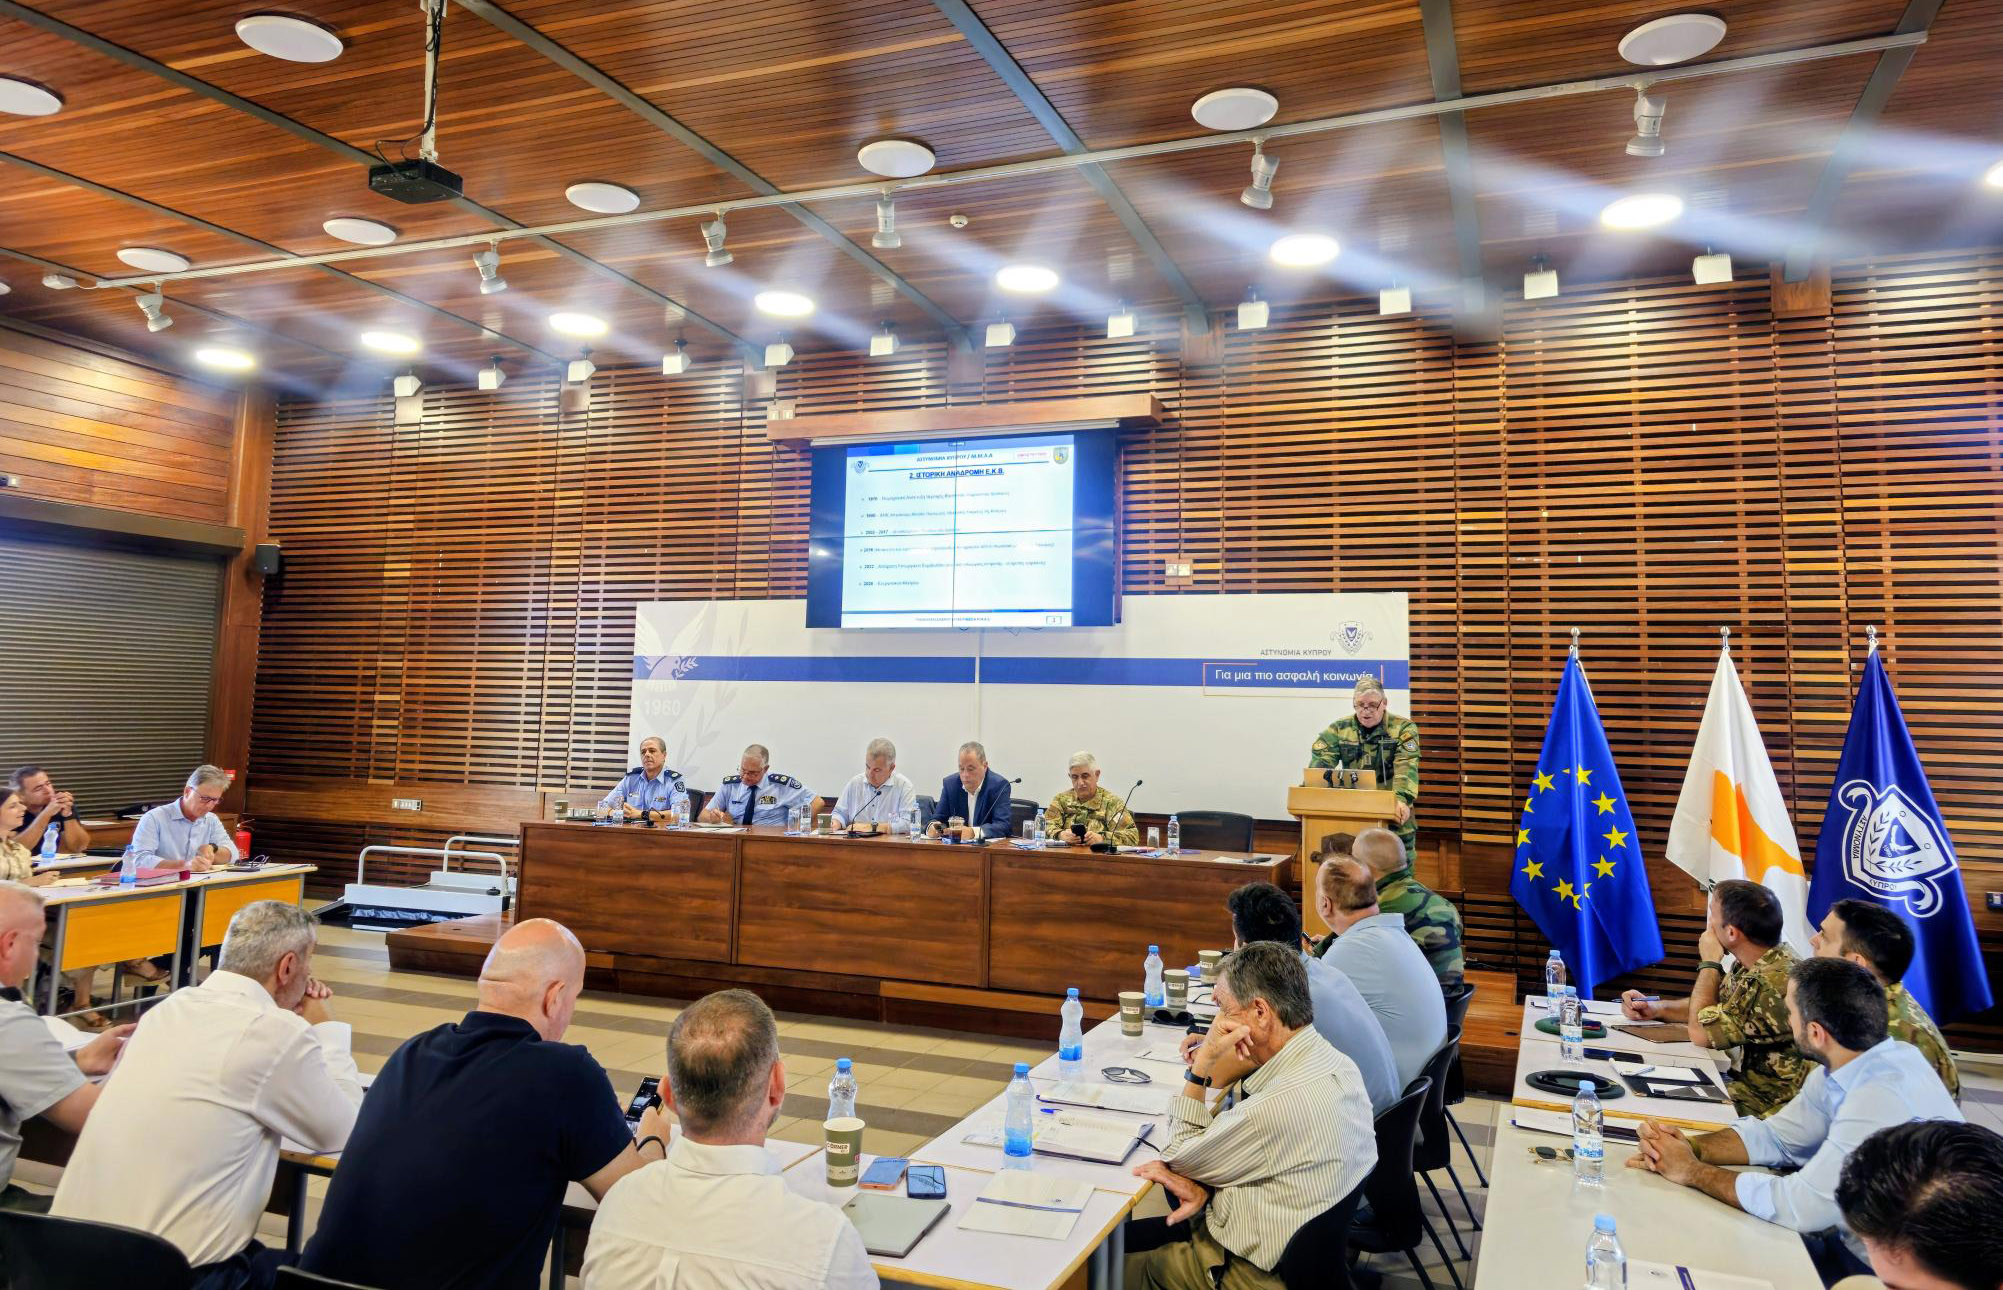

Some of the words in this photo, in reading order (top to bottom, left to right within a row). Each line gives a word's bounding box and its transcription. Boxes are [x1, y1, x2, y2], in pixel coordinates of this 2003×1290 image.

[1215, 669, 1231, 680] Για
[1234, 670, 1251, 682] μια
[1255, 671, 1273, 680] πιο
[1275, 670, 1320, 683] ασφαλή
[643, 699, 681, 716] 1960
